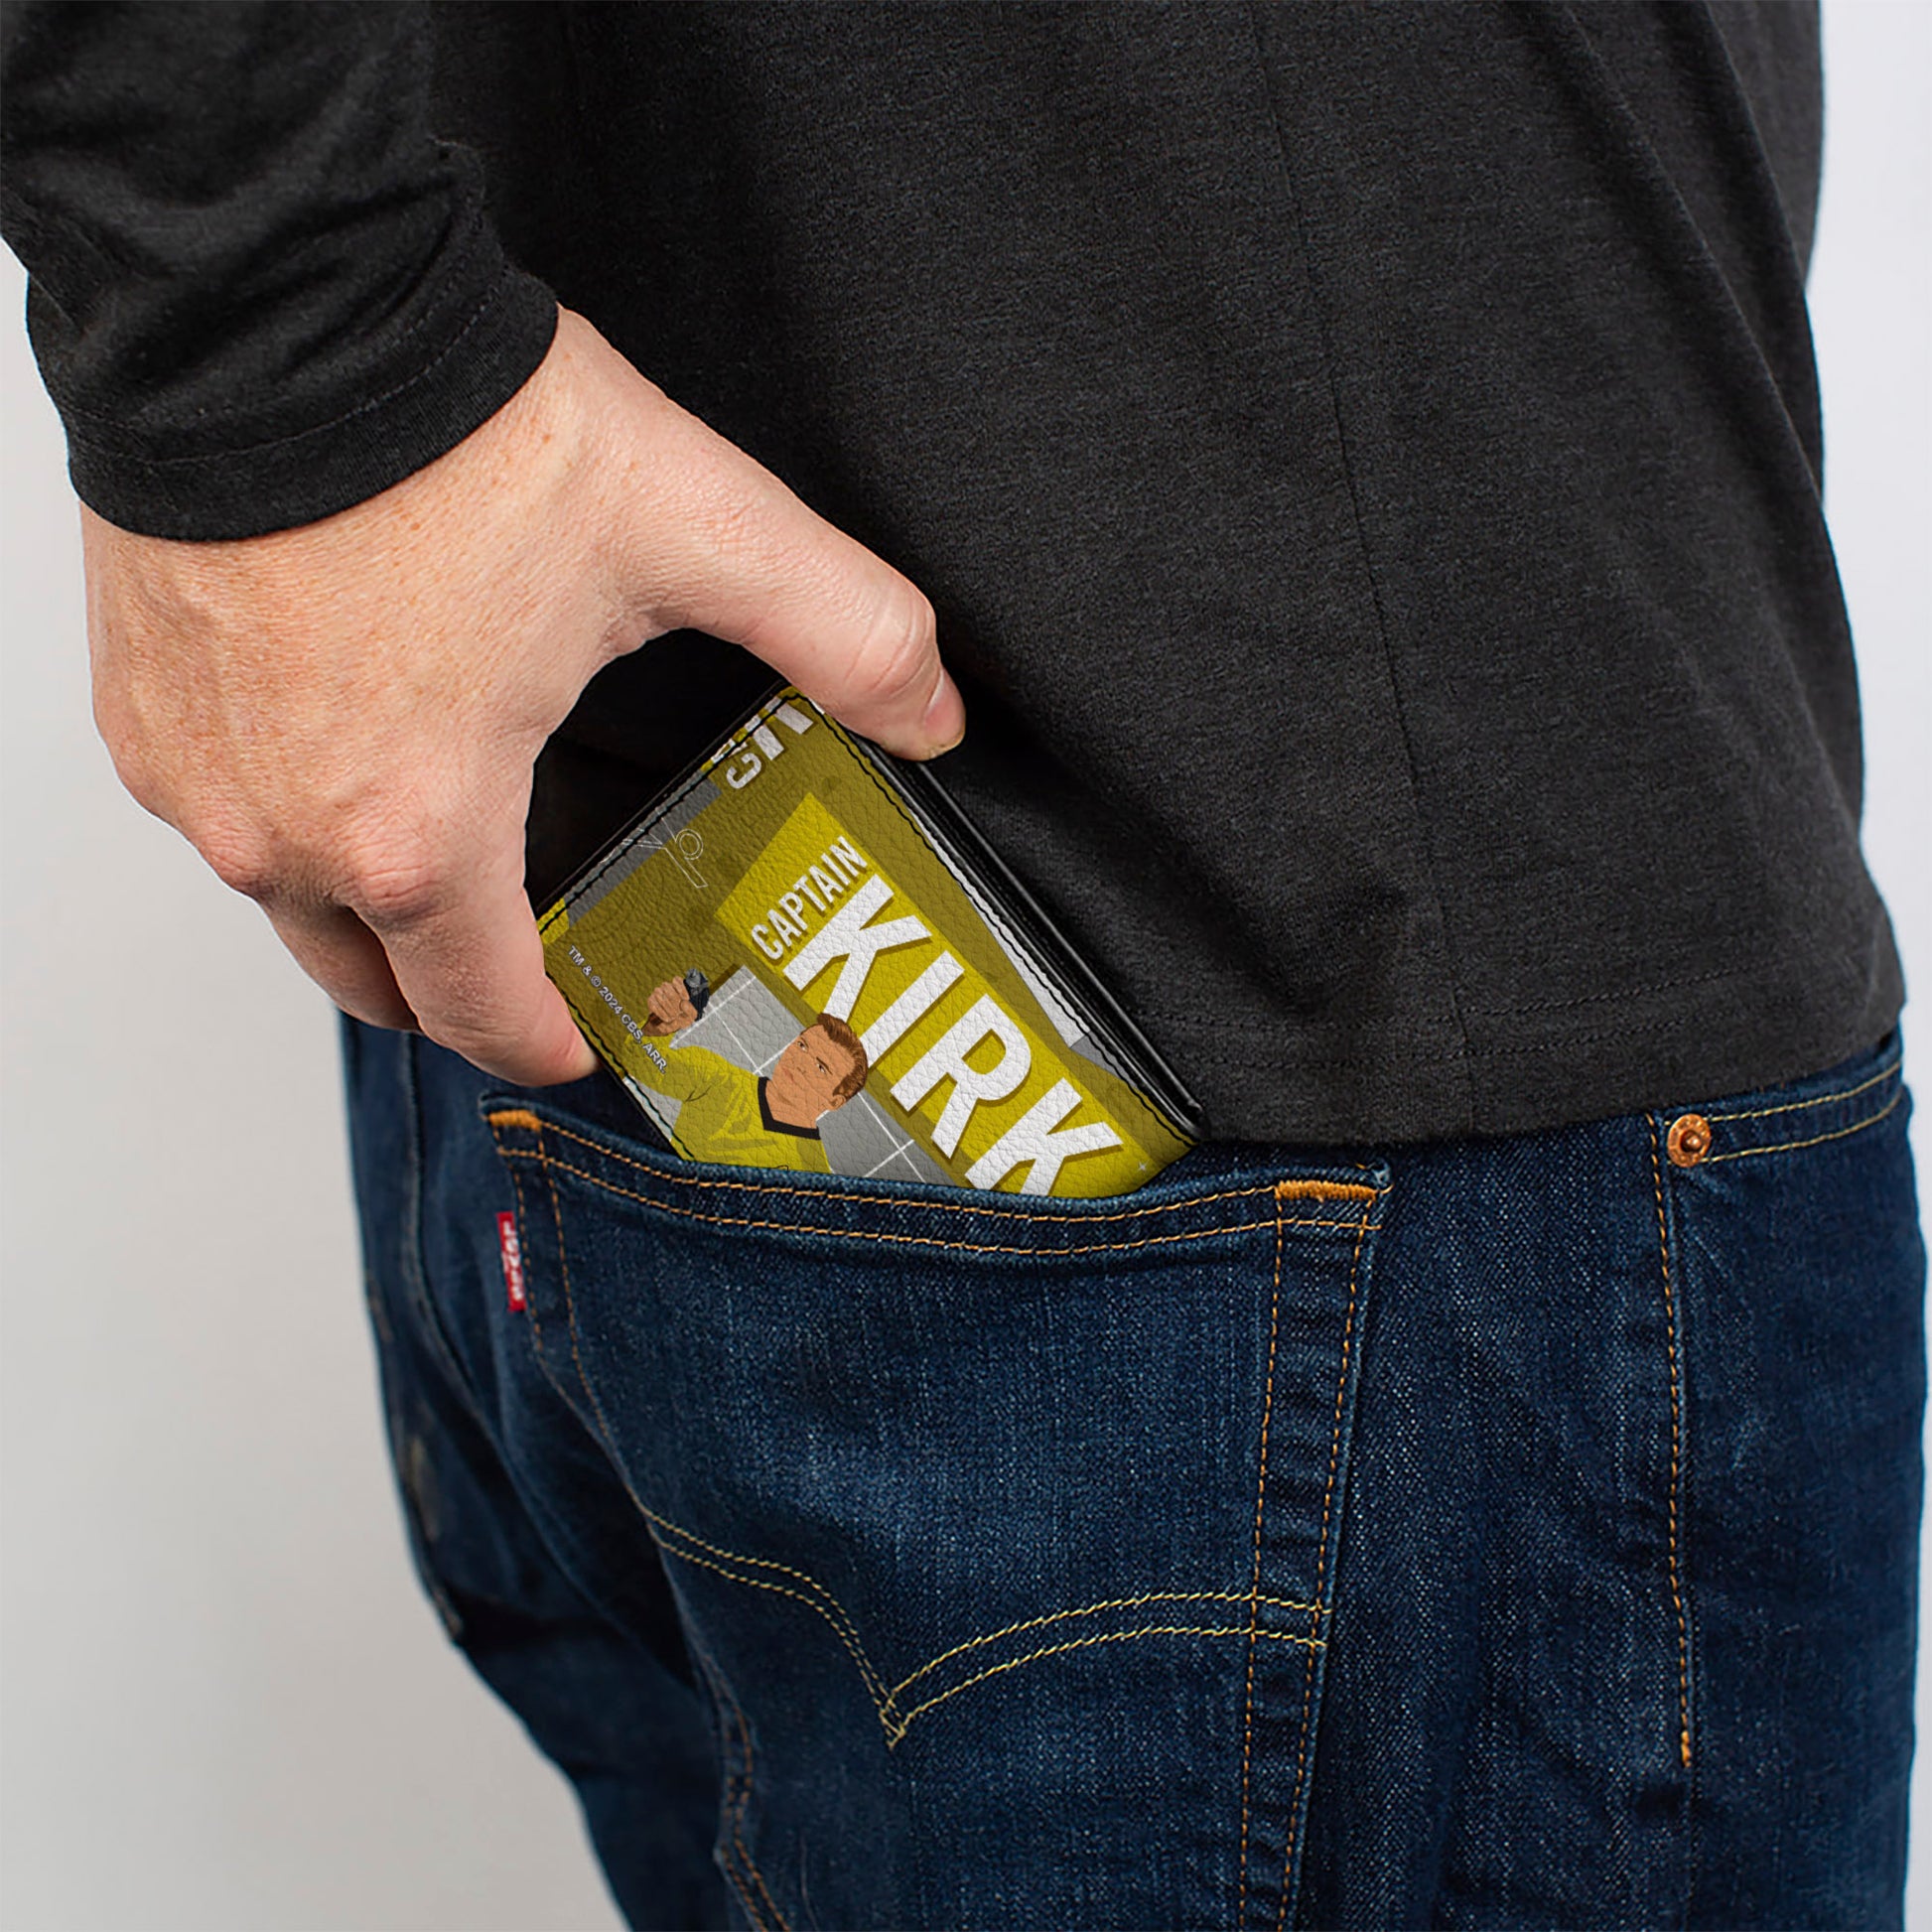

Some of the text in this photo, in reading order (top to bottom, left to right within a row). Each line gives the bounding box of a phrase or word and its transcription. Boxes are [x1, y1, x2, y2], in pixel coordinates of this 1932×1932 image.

[751, 836, 868, 960] CAPTAIN
[568, 945, 585, 966] TM
[582, 965, 593, 977] &
[591, 975, 602, 988] ©
[599, 986, 623, 1015] 2024
[643, 1042, 668, 1074] ARR.
[782, 874, 1123, 1196] KIRK
